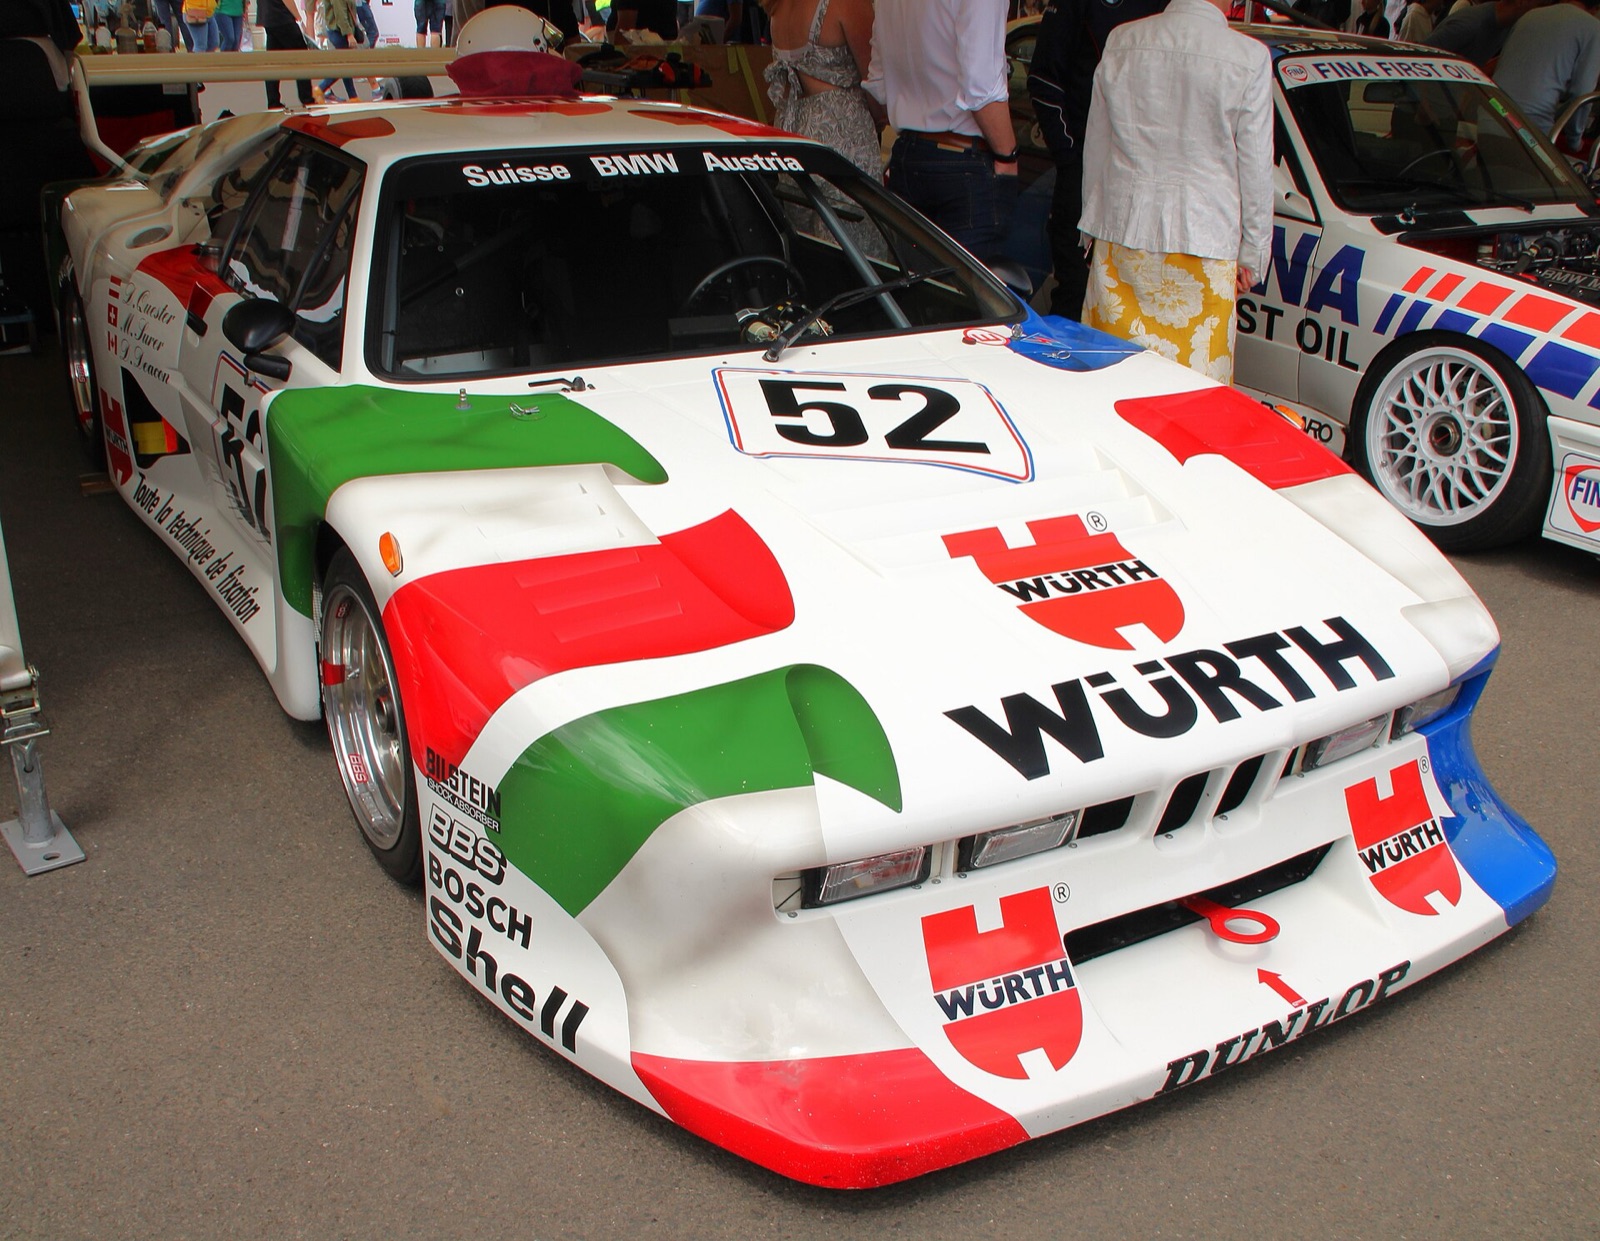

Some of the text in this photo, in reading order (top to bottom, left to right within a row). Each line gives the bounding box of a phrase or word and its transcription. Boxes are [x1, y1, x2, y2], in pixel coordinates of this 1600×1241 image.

[1287, 67, 1305, 77] FINA
[1312, 61, 1480, 81] FINA FIRST OIL
[462, 162, 572, 187] Suisse
[589, 152, 680, 177] BMW
[701, 151, 805, 172] Austria
[1250, 224, 1366, 327] NA
[1540, 269, 1588, 285] BMW
[1296, 316, 1359, 373] OIL
[758, 378, 991, 455] 52
[1570, 475, 1600, 509] FIN
[132, 472, 261, 625] Toute la technique de fixation
[997, 560, 1159, 603] WÜRTH
[942, 615, 1396, 782] WÜRTH
[350, 755, 368, 784] BBS
[426, 747, 501, 818] BILSTEIN
[427, 777, 500, 832] SHOCK ABSORBER
[428, 803, 507, 886] BBS
[1358, 818, 1444, 875] WÜRTH
[428, 850, 533, 951] BOSCH
[430, 895, 590, 1055] Shell
[933, 958, 1076, 1022] WÜRTH
[1152, 959, 1411, 1097] DUNLOP
